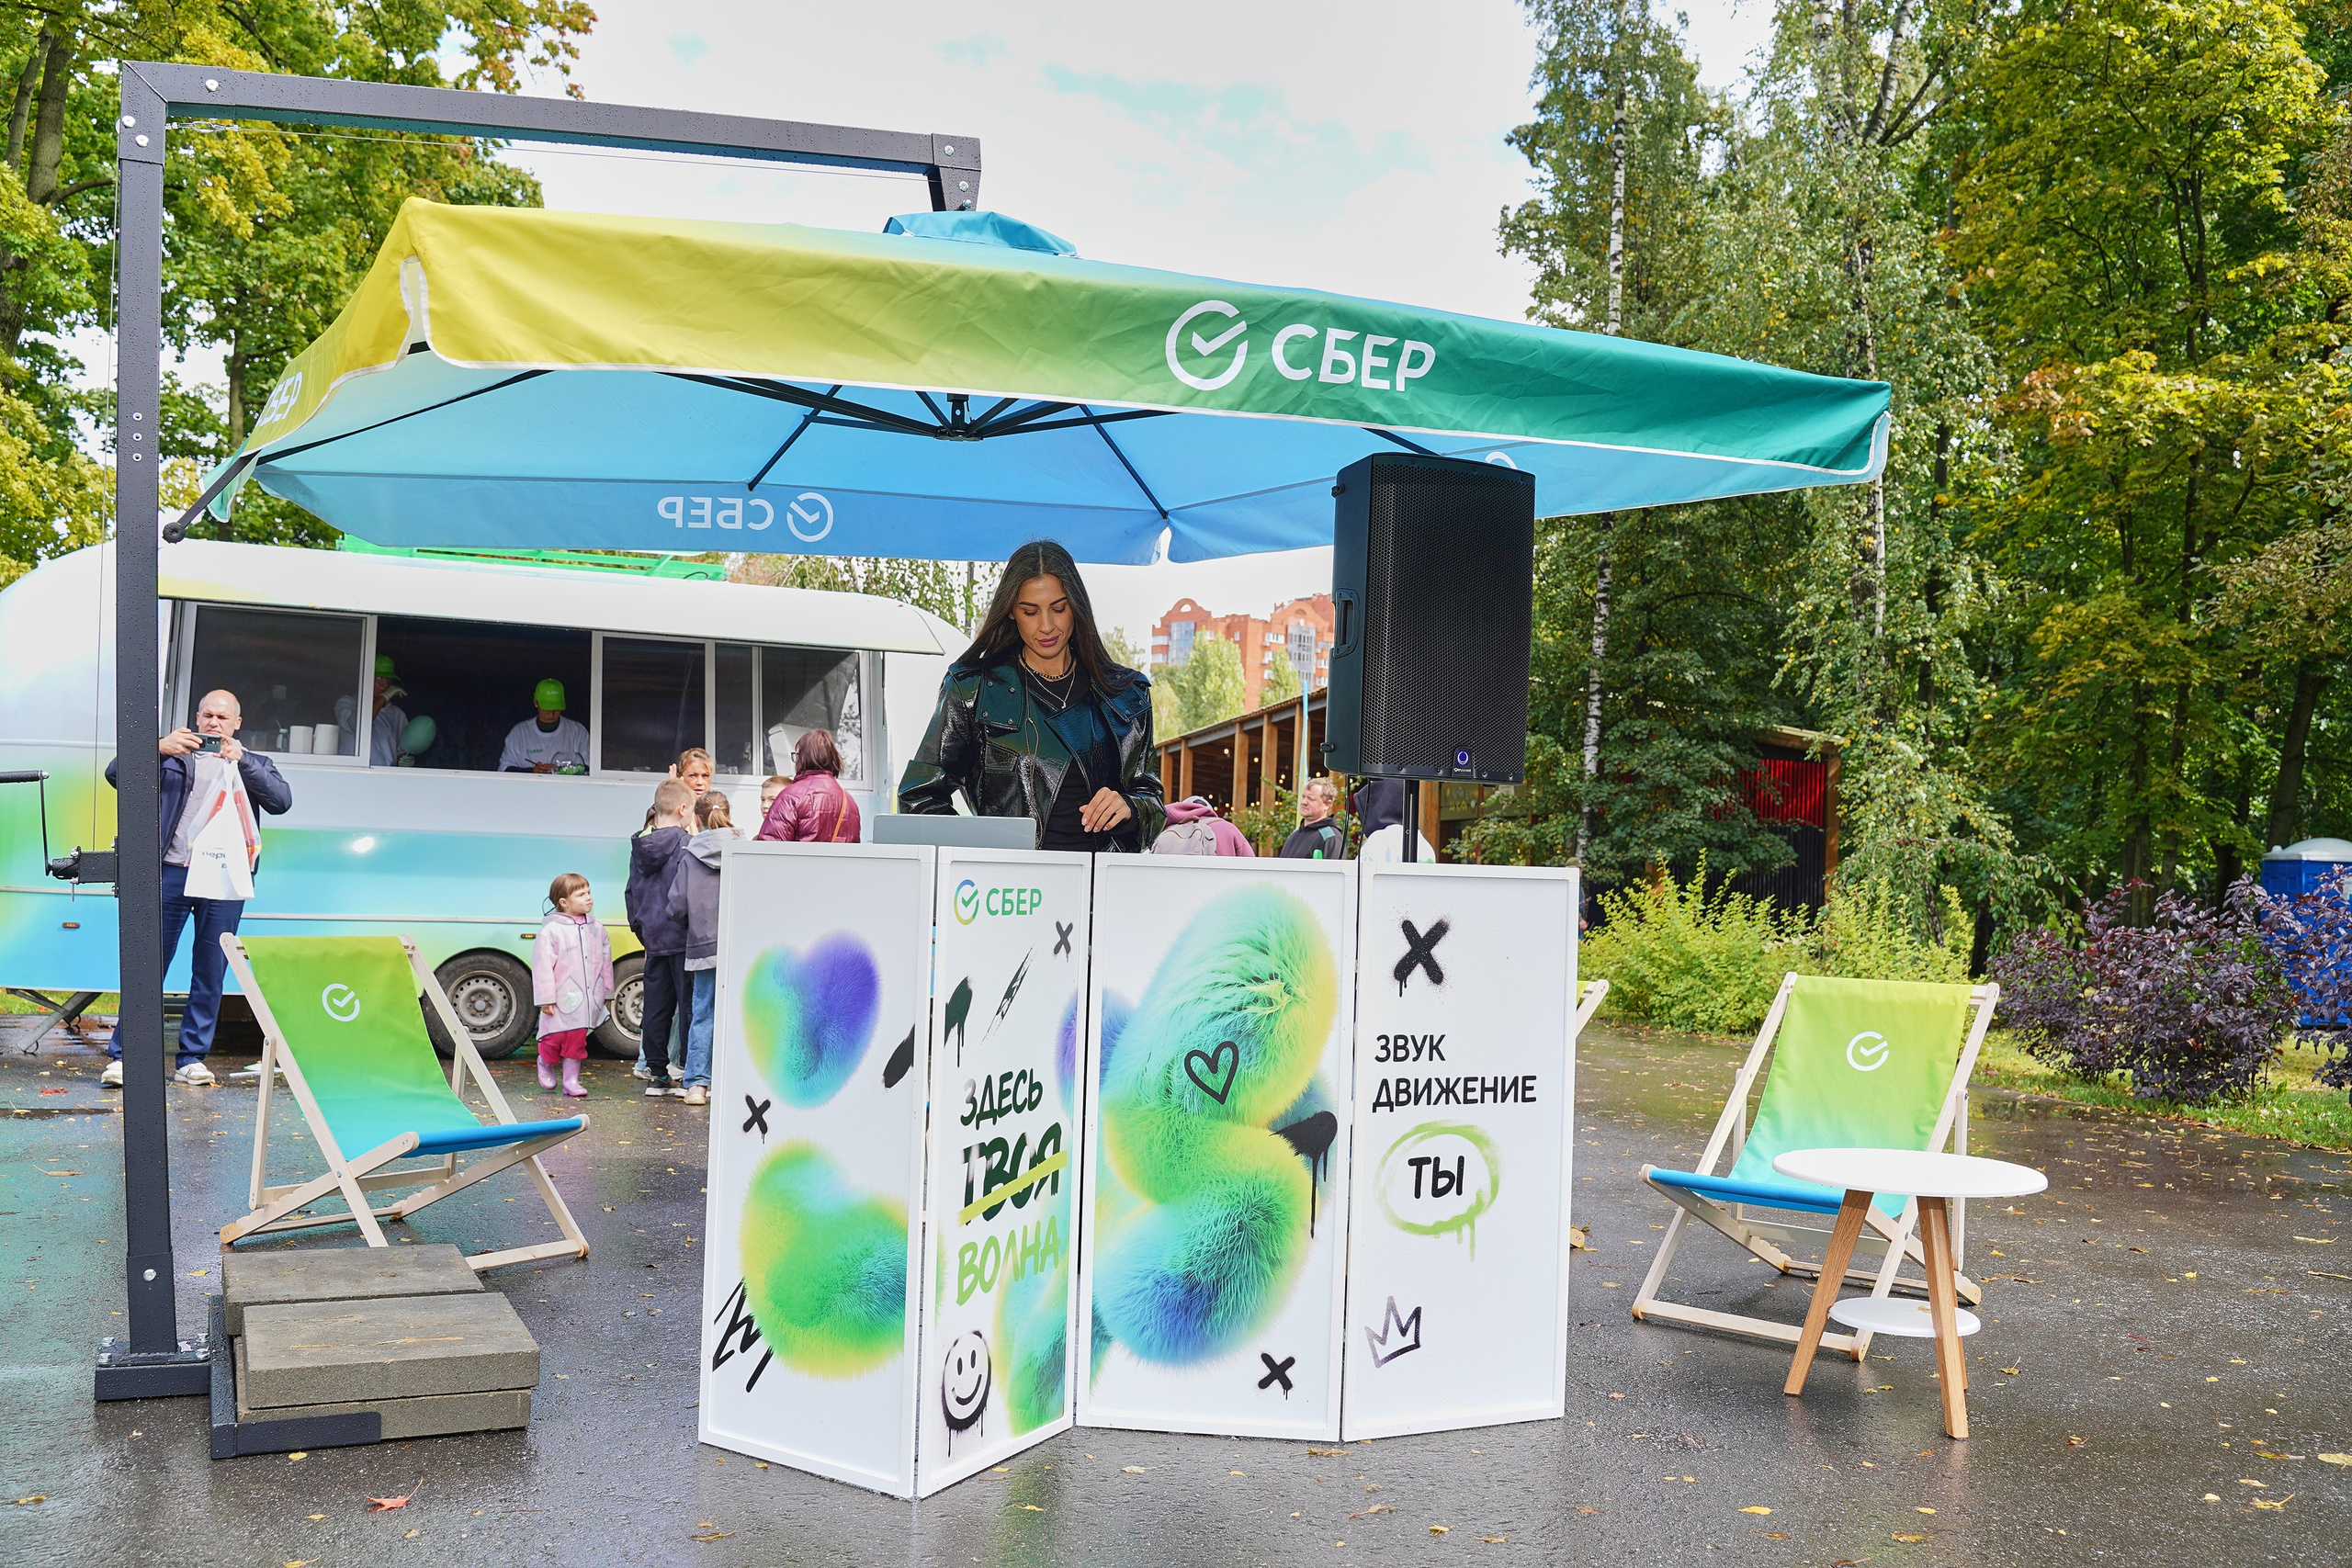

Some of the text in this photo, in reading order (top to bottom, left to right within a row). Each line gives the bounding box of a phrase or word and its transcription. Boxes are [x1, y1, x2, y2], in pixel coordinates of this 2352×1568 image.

[1272, 323, 1436, 392] СБЕР
[986, 887, 1042, 916] СБЕР
[1374, 1034, 1446, 1063] ЗВУК
[960, 1068, 1044, 1131] ЗДЕСЬ
[1372, 1075, 1537, 1113] ДВИЖЕНИЕ
[962, 1122, 1063, 1226] ТВОЯ
[1408, 1155, 1464, 1199] ТЫ
[956, 1214, 1061, 1306] ВОЛНА
